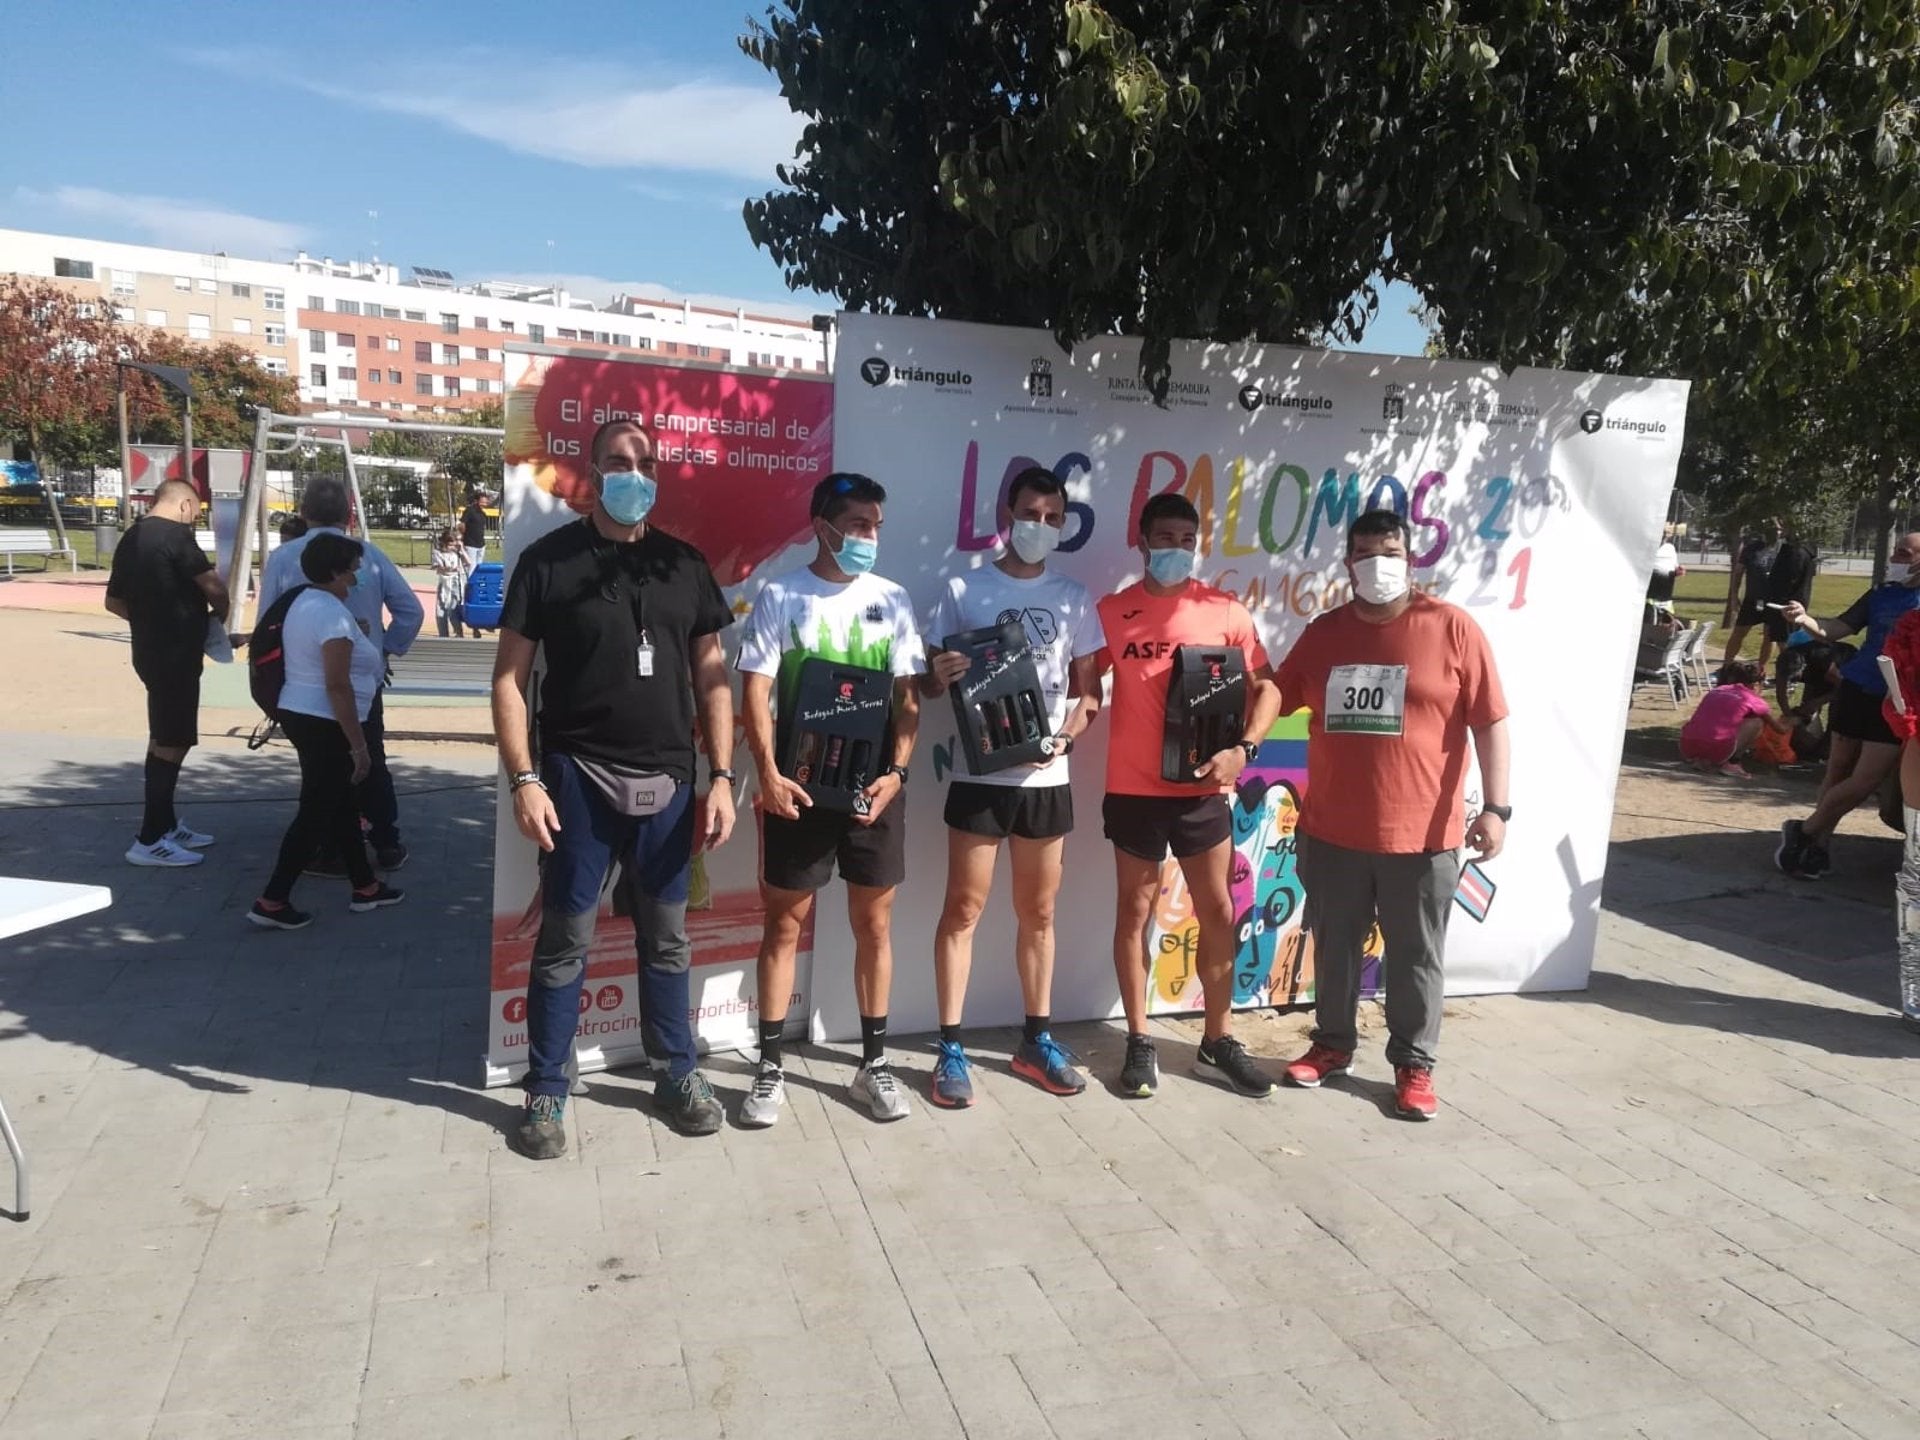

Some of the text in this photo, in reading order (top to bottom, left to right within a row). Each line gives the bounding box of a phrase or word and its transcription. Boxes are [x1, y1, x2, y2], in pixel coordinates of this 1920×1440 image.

[894, 365, 972, 386] triángulo
[1265, 392, 1333, 411] triángulo
[561, 399, 582, 423] El
[653, 412, 776, 439] empresarial
[785, 420, 809, 439] de
[1606, 417, 1667, 434] triángulo
[547, 432, 819, 475] los tistas olímpicos
[1126, 450, 1450, 569] PALOMOS
[1278, 570, 1319, 617] 16
[1343, 686, 1384, 710] 300
